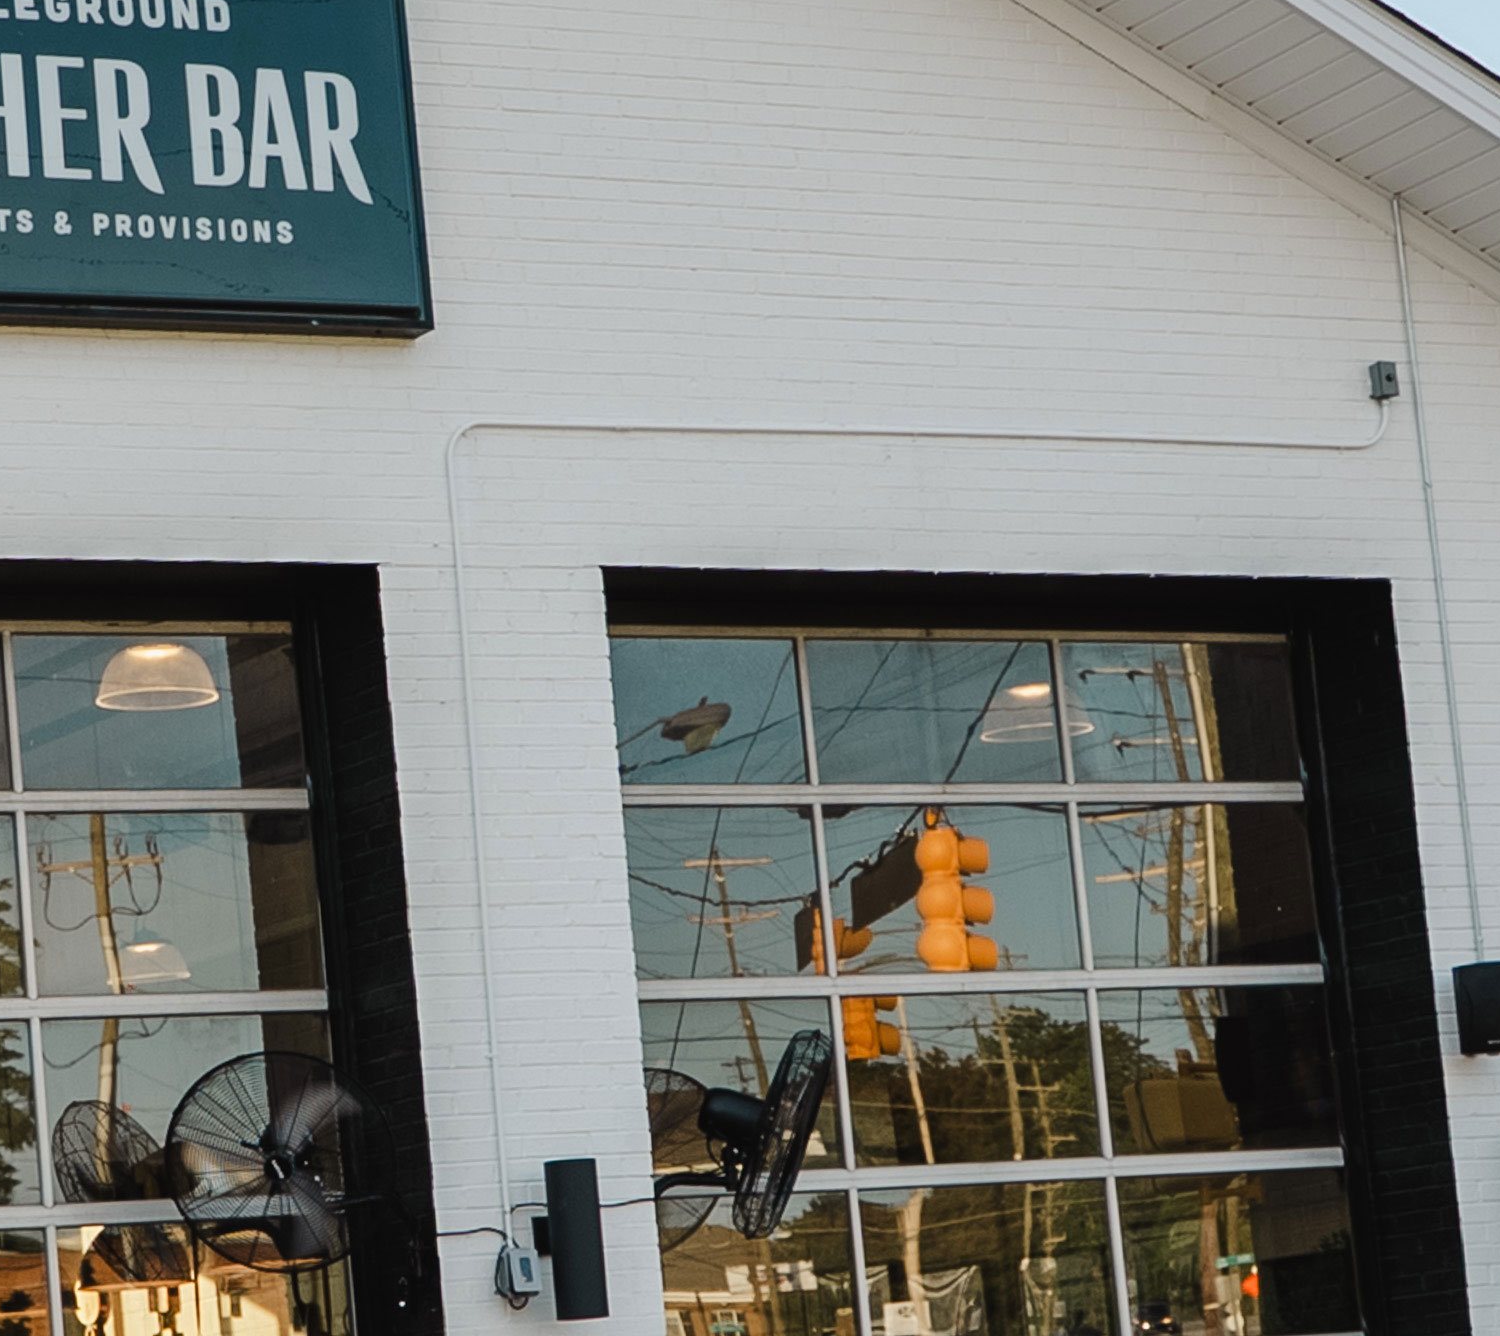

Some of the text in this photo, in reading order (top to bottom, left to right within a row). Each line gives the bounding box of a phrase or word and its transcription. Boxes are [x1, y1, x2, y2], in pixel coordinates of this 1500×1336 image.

[185, 63, 373, 205] BAR
[53, 211, 73, 236] &
[92, 212, 294, 244] PROVISIONS
